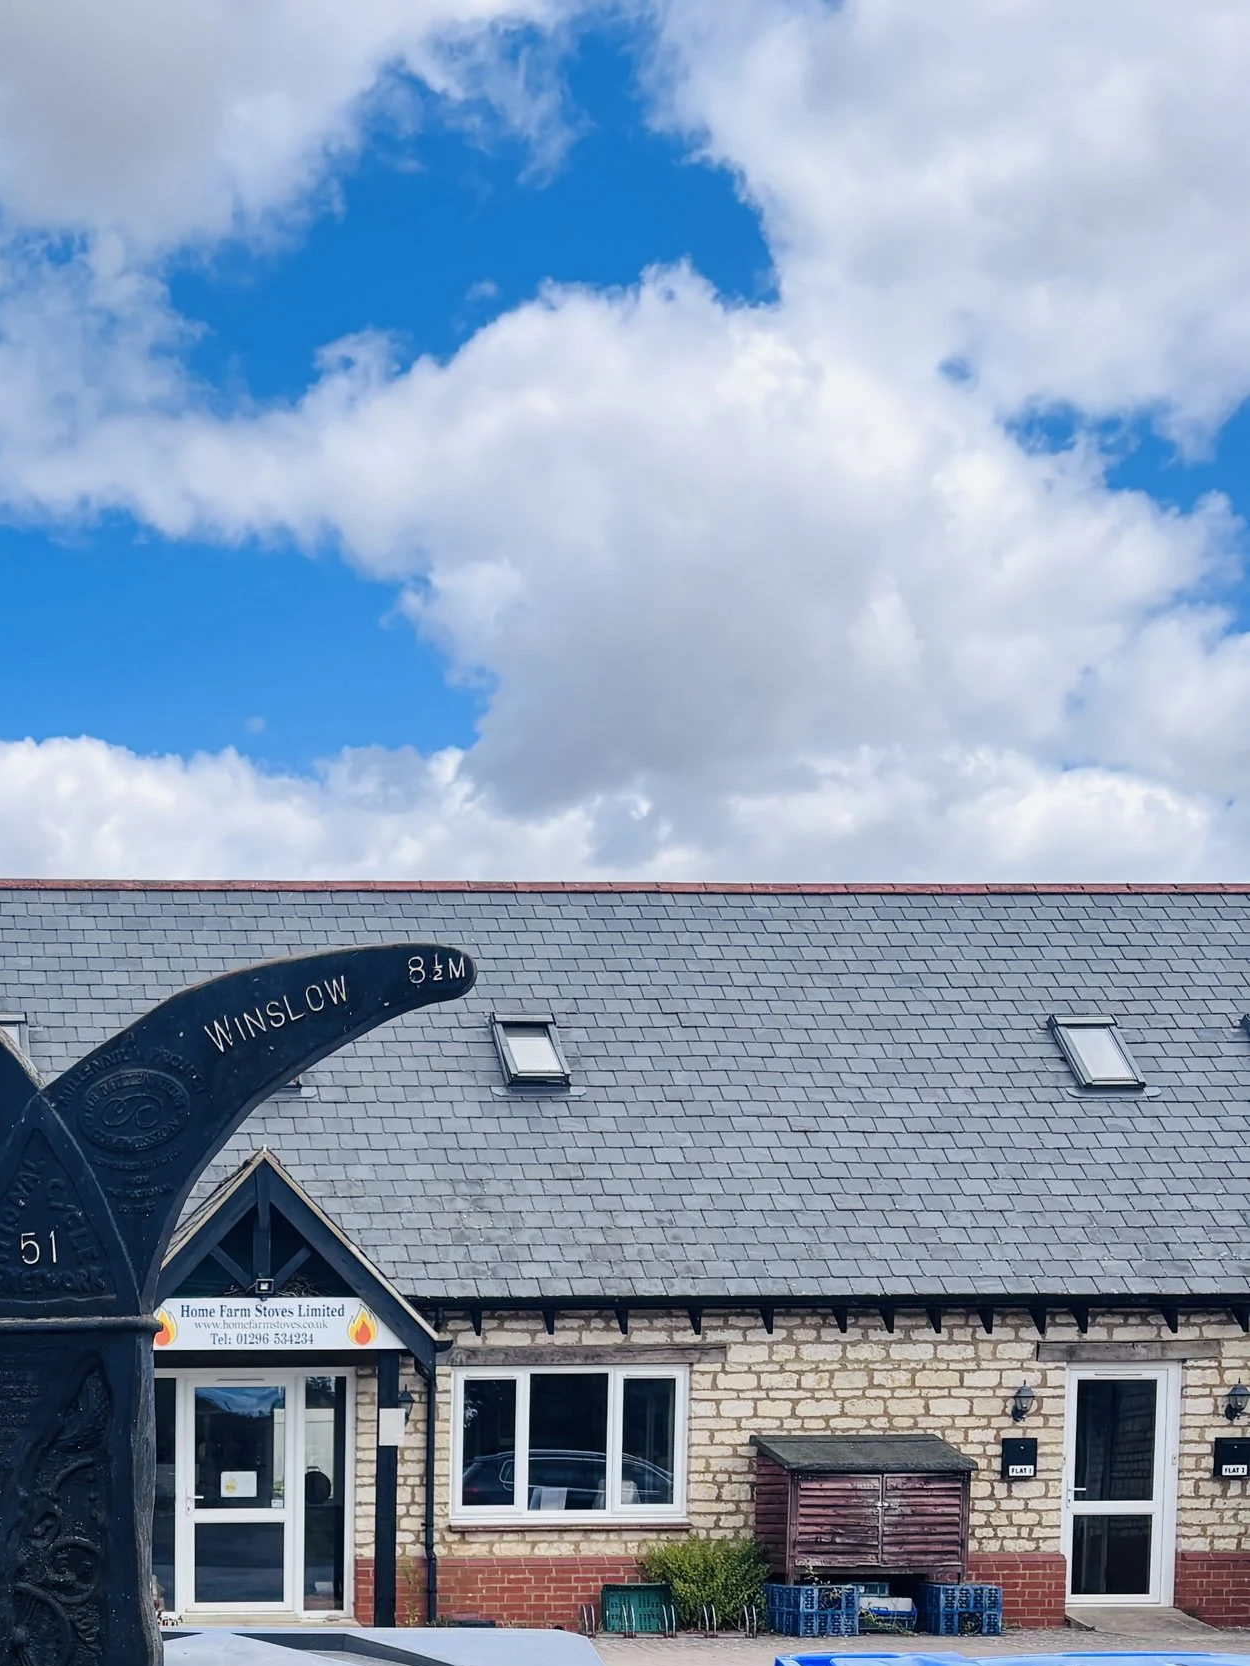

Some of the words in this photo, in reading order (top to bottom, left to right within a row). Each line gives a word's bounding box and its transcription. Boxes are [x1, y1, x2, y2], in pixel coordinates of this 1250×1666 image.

[204, 974, 349, 1055] WINSLOW
[20, 1230, 58, 1265] 51
[181, 1304, 216, 1320] Home
[219, 1304, 251, 1320] Farm
[254, 1303, 294, 1319] Stoves
[297, 1303, 346, 1318] Limited
[210, 1332, 232, 1345] Tel:
[235, 1332, 270, 1345] 01296
[273, 1332, 315, 1345] 534234
